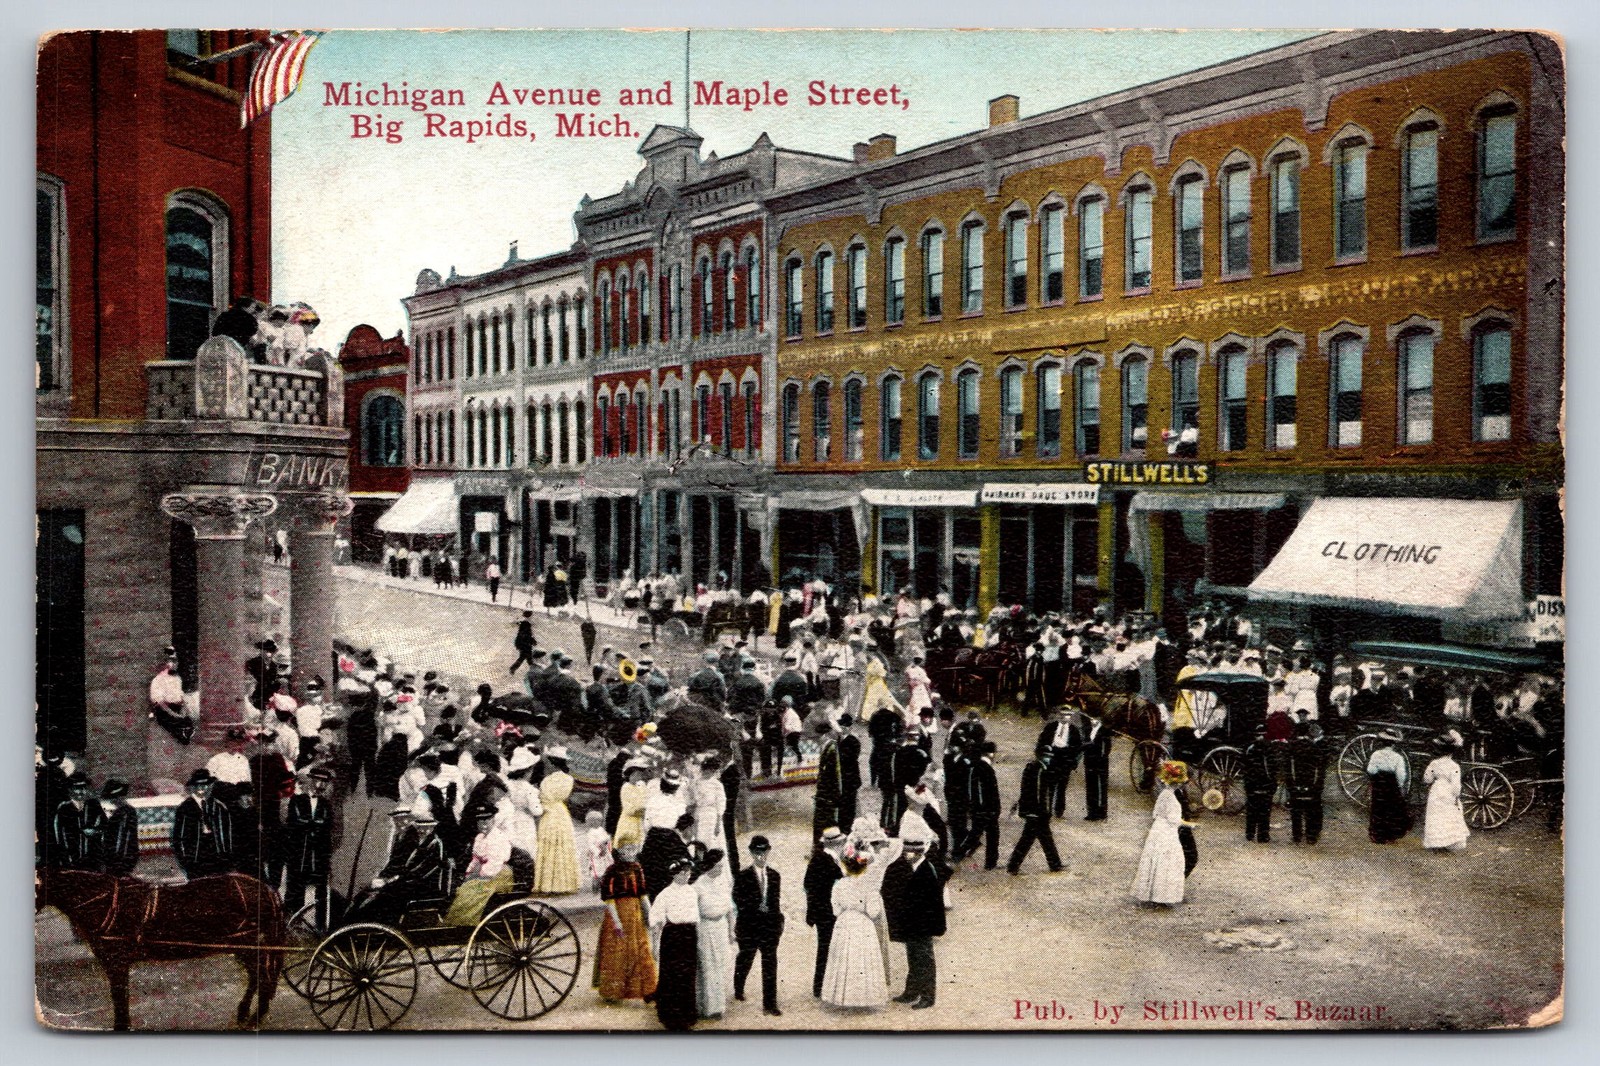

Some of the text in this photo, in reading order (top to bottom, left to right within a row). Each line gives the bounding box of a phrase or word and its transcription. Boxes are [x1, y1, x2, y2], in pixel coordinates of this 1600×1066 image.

[256, 453, 338, 486] BANK
[1086, 463, 1209, 484] STILLWELL'S
[1064, 490, 1096, 499] STORE
[1321, 541, 1441, 564] CLOTHING
